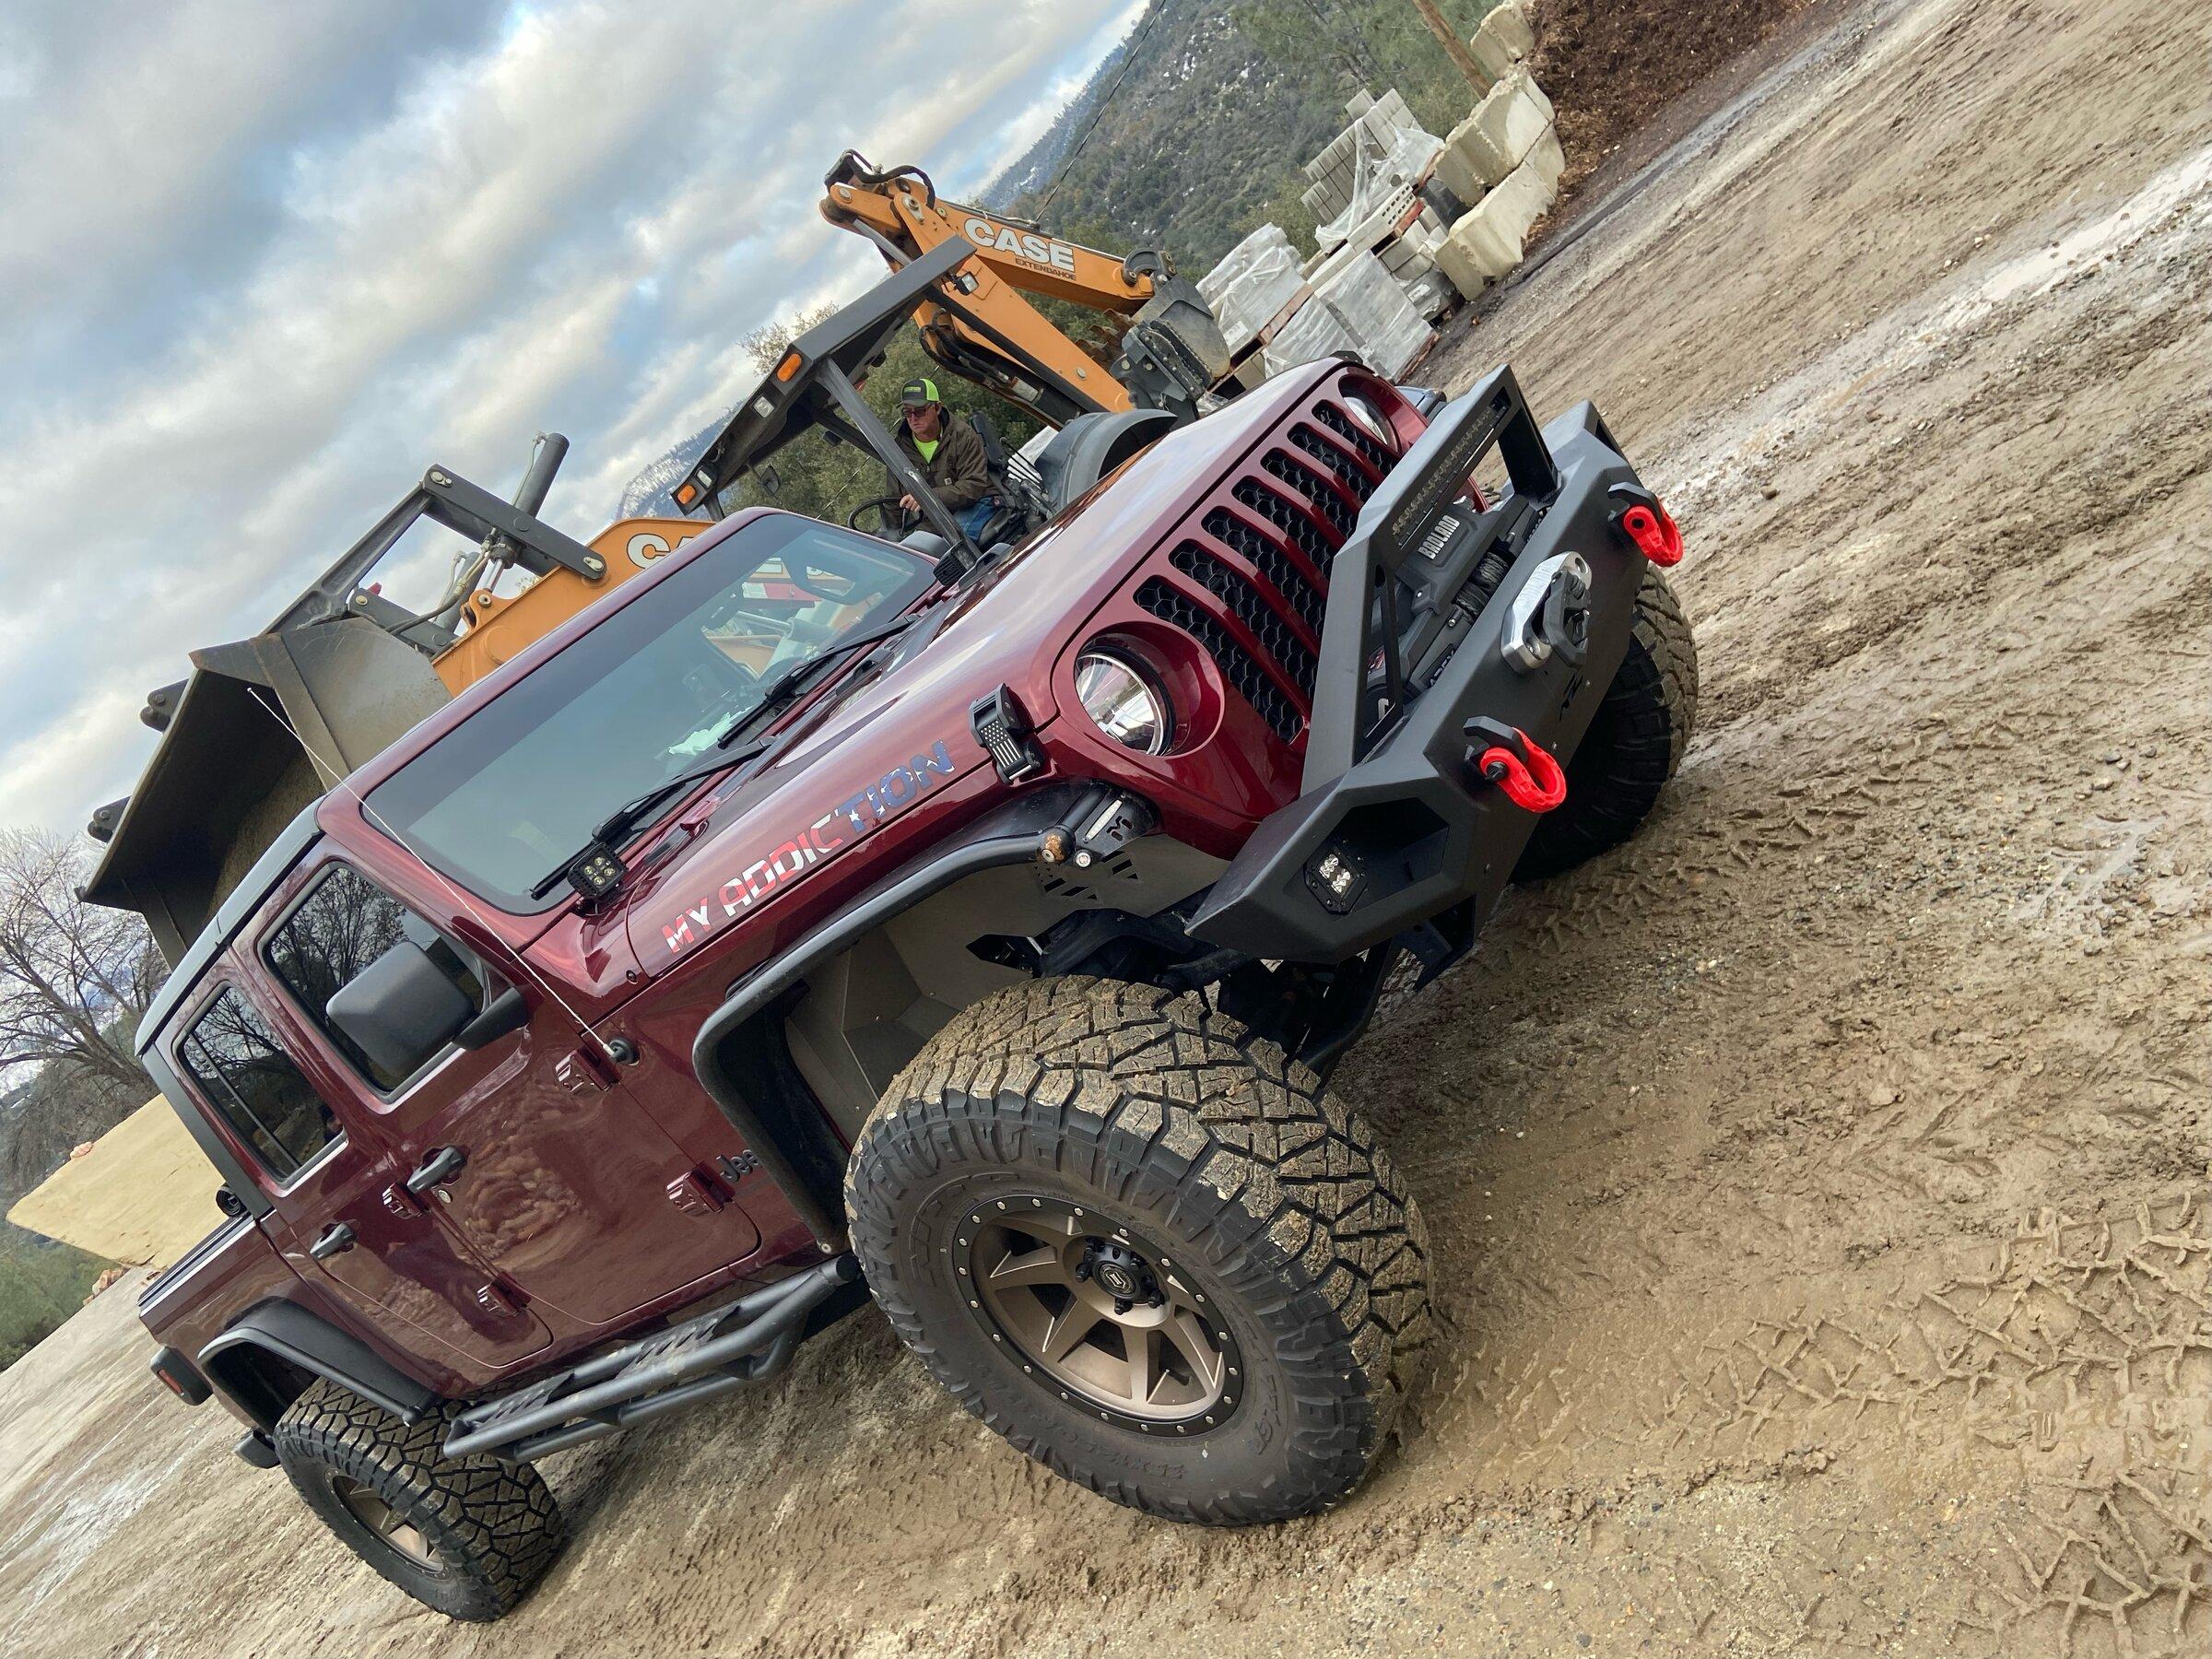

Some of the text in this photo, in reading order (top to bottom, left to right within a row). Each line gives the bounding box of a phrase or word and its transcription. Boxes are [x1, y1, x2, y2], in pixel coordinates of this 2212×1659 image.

[964, 218, 1076, 273] CASE
[1015, 258, 1077, 280] EXTENDAHOE
[1418, 514, 1461, 559] BADLAND
[662, 739, 956, 954] MY ADDICTION
[716, 1149, 759, 1182] Jee
